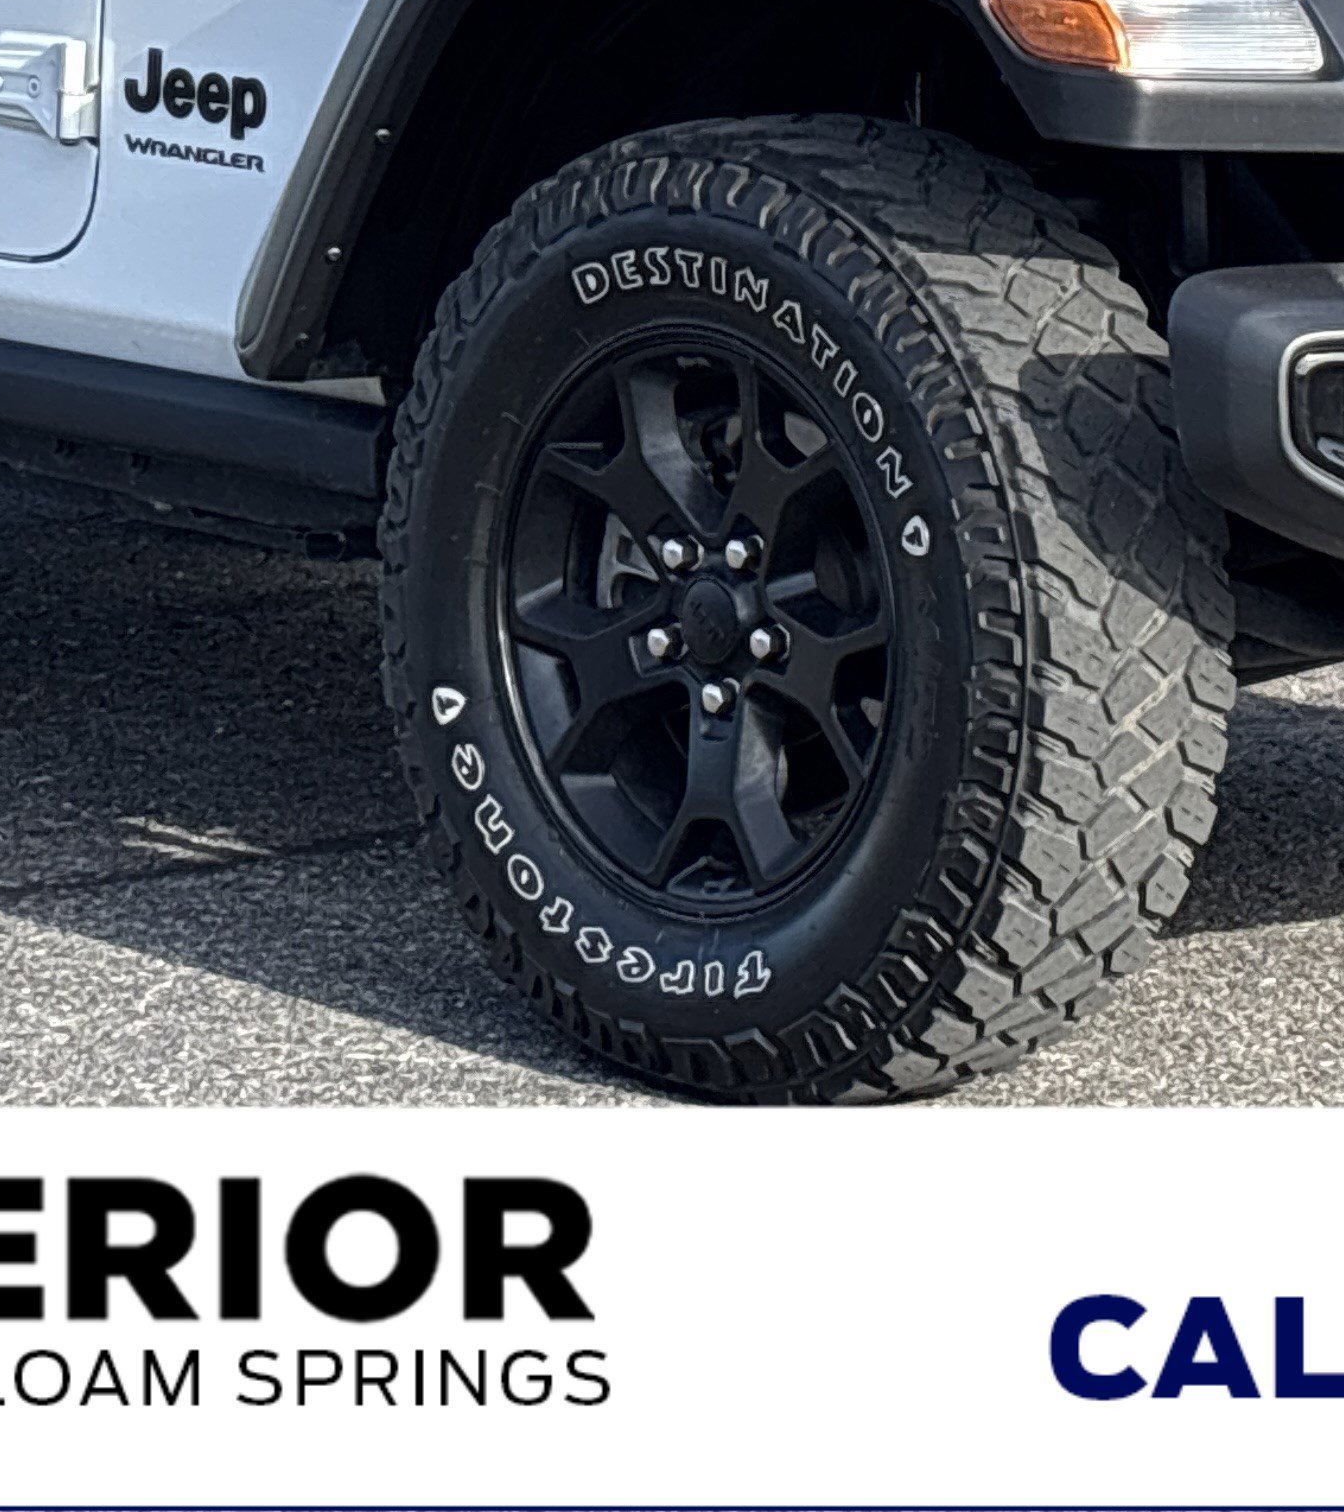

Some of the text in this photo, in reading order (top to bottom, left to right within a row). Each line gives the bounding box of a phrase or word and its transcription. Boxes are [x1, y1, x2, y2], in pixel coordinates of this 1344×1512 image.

[124, 46, 267, 140] Jeep
[124, 133, 266, 174] WRANGLER
[571, 245, 914, 501] DESTINATION
[452, 742, 772, 1000] Firestone
